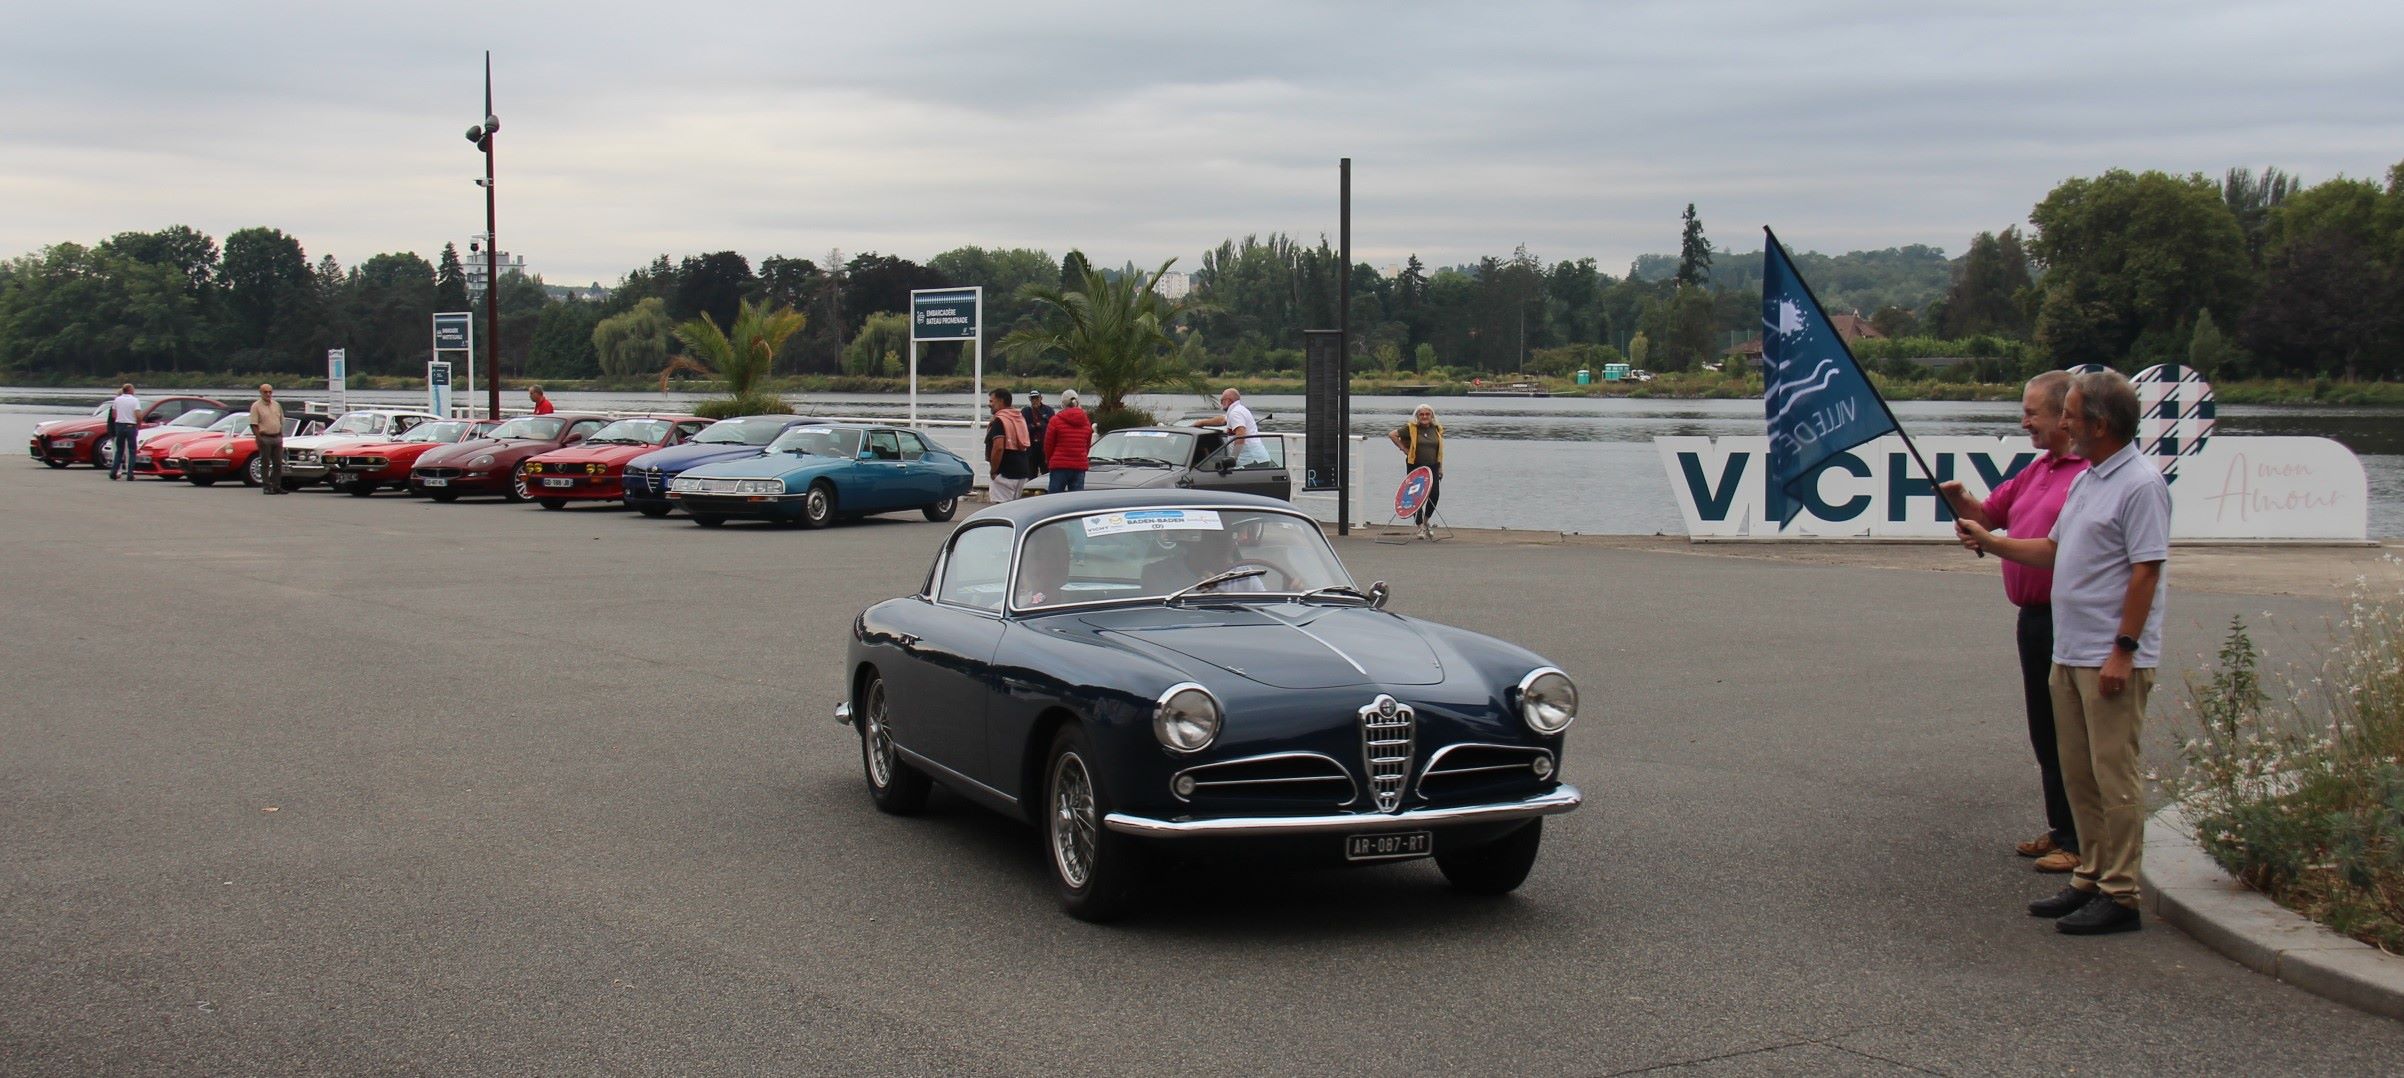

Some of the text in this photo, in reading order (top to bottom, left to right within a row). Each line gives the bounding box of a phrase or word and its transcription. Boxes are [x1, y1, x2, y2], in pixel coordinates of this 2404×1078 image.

[926, 316, 968, 325] BATEAU PROMENADE
[2257, 462, 2314, 477] mon
[2201, 452, 2345, 523] Amour
[1127, 517, 1185, 525] BADEN-BADEN
[1353, 835, 1425, 855] AR-087-RT
